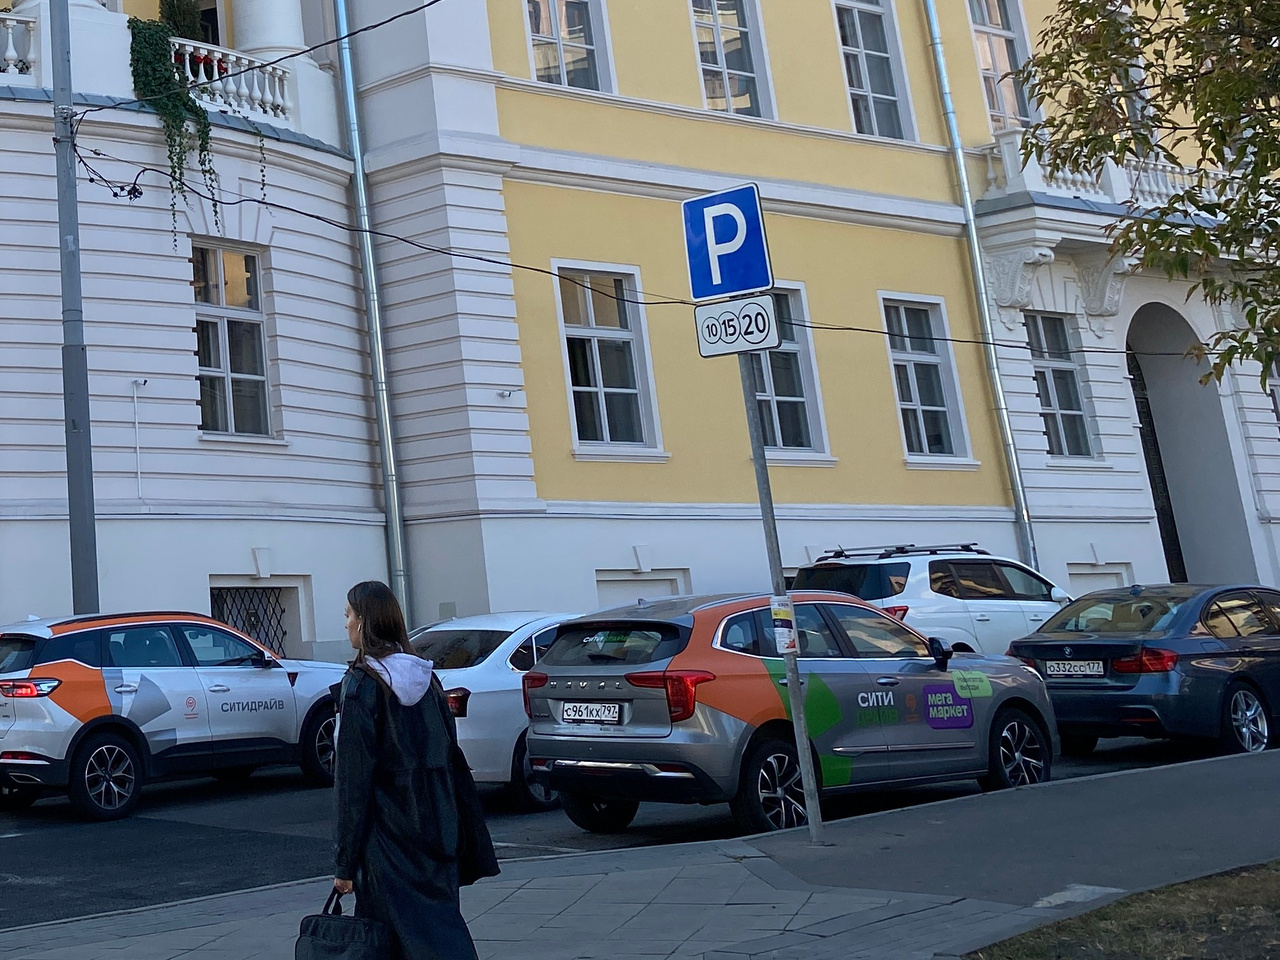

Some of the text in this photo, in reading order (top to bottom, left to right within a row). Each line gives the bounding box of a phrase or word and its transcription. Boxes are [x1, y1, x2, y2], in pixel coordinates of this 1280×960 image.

[703, 202, 747, 285] P
[705, 311, 767, 339] 10 15 20
[1086, 661, 1100, 671] 177
[221, 698, 284, 713] СИТИДРАЙВ
[857, 691, 894, 707] СИТИ
[928, 693, 953, 705] мега
[602, 705, 616, 716] 797
[929, 705, 968, 720] маркет
